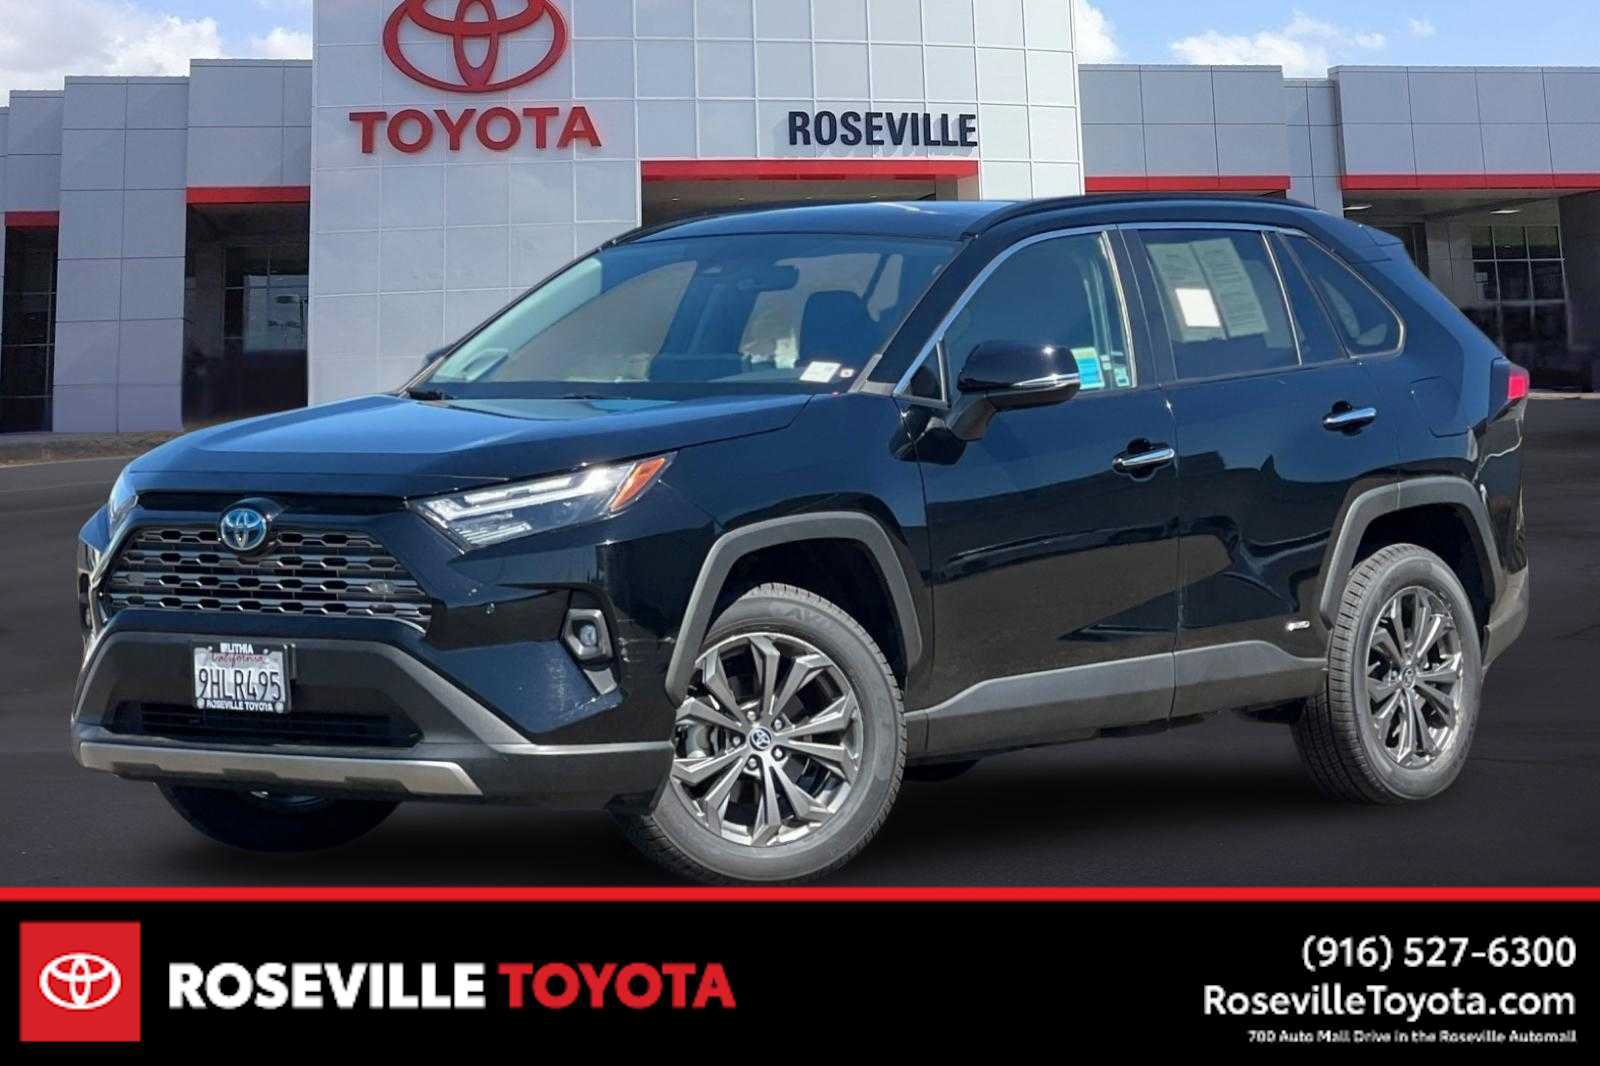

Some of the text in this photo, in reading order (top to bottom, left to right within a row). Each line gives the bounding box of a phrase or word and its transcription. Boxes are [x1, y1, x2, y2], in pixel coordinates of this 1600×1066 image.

[349, 105, 602, 153] TOYOTA
[788, 110, 978, 147] ROSEVILLE
[227, 643, 254, 654] LITHIA
[199, 668, 281, 701] 9HLR495
[206, 700, 274, 712] ROSEVILLE TOYOTA
